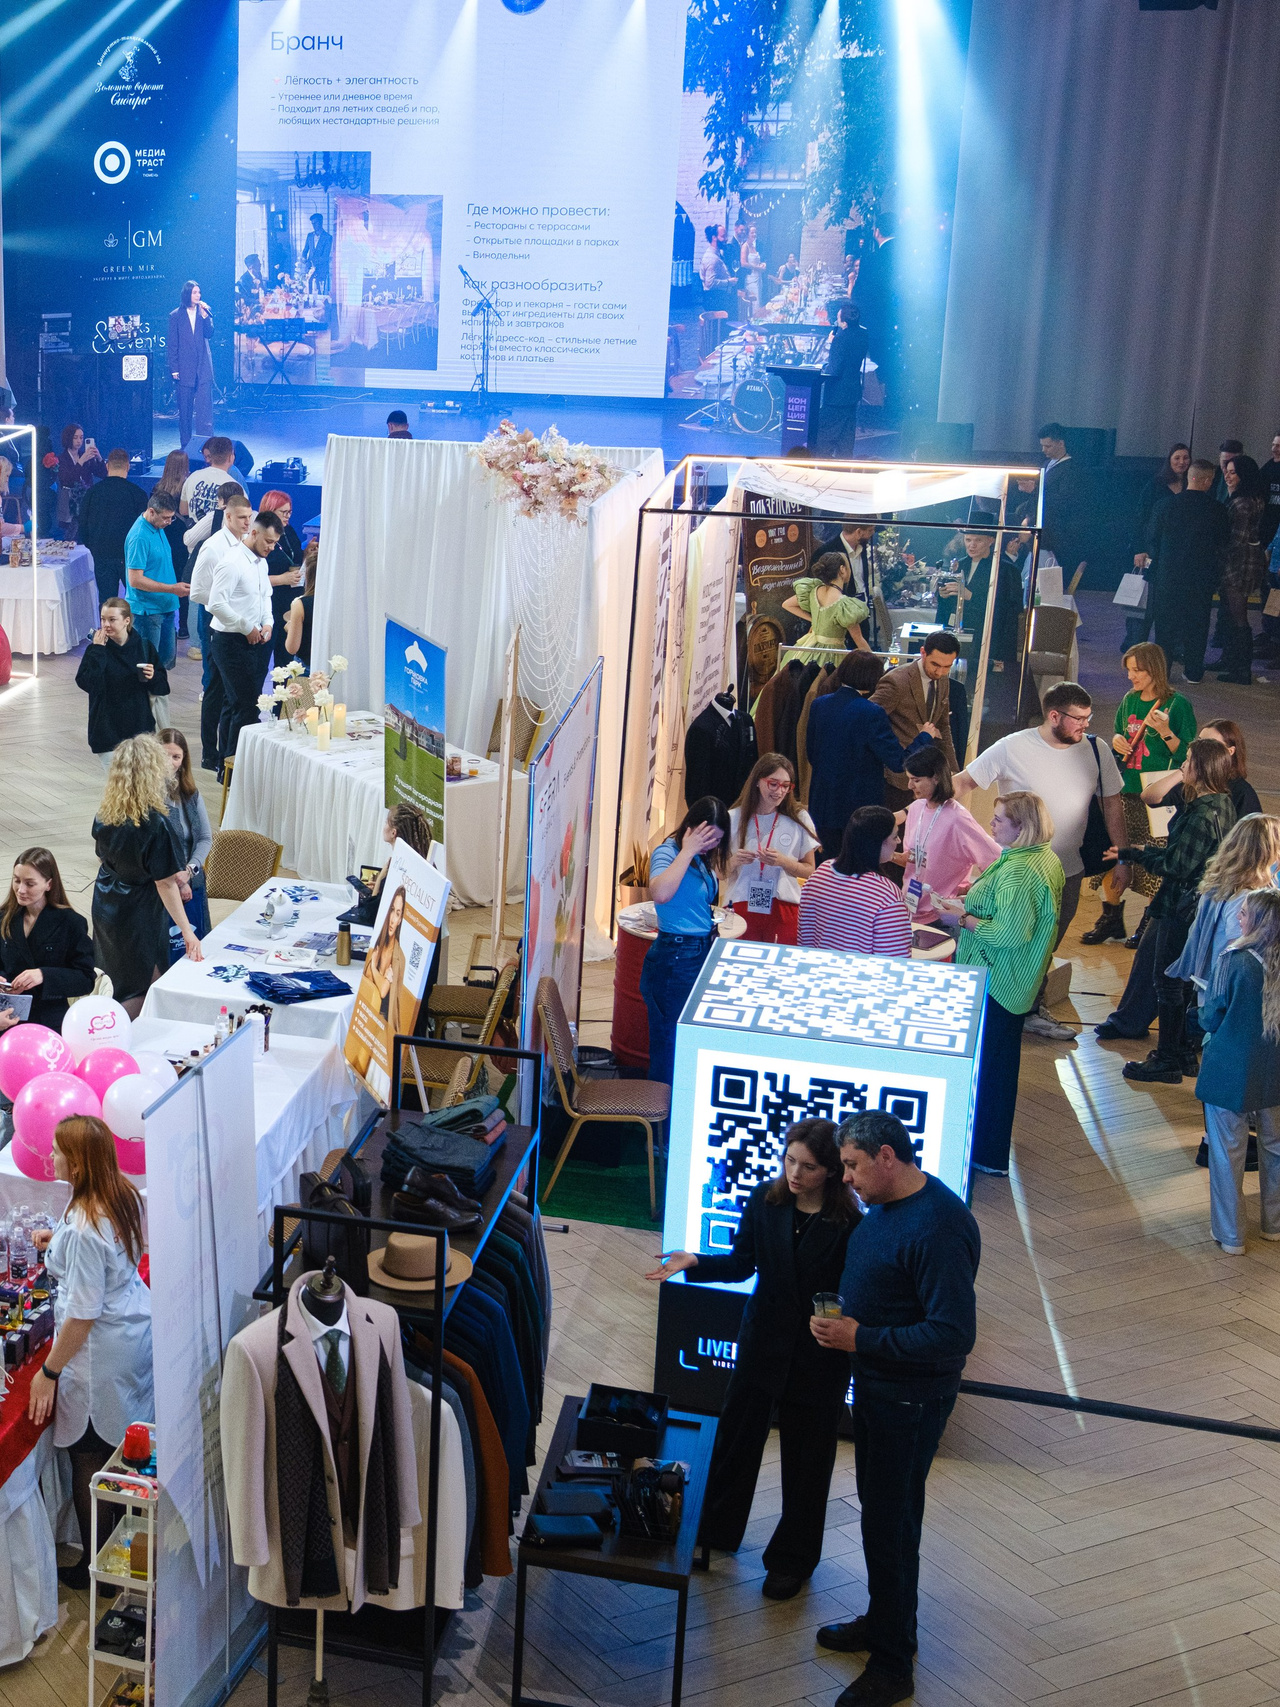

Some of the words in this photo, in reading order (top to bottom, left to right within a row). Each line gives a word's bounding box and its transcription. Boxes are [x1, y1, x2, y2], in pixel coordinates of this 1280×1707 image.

[271, 31, 343, 54] Бранч
[284, 75, 332, 85] Лёгкость
[345, 76, 419, 85] элегантность
[95, 81, 132, 93] Золотые
[134, 82, 164, 94] ворота
[278, 93, 321, 101] Утреннее
[278, 105, 321, 113] Подходит
[376, 104, 410, 113] свадеб
[278, 117, 320, 126] любящих
[322, 118, 395, 126] нестандартные
[397, 118, 440, 126] решения
[135, 149, 166, 157] МЕДИА
[136, 158, 164, 167] ТРАСТ
[467, 203, 489, 216] Где
[492, 206, 538, 216] можно
[542, 206, 610, 218] провести:
[474, 221, 527, 231] Рестораны
[537, 223, 591, 232] террасами
[132, 229, 162, 248] GM
[473, 236, 522, 245] Открытые
[524, 238, 574, 246] площадки
[584, 239, 620, 247] парках
[473, 251, 530, 260] Винодельни
[103, 265, 133, 273] GREEN
[138, 264, 155, 272] MIR
[463, 278, 487, 289] Как
[491, 279, 603, 292] разнообразить?
[462, 298, 513, 308] Фре-бар
[523, 301, 564, 309] пекарня
[462, 309, 510, 318] выают
[512, 311, 575, 320] ингредиенты
[577, 312, 594, 320] для
[462, 319, 505, 327] напиов
[515, 321, 564, 329] завтраков
[461, 332, 494, 342] Лёгкй
[496, 334, 545, 343] дресс-код
[555, 336, 601, 345] стильные
[603, 337, 637, 345] летние
[460, 343, 497, 351] нары
[535, 346, 601, 354] классических
[460, 353, 506, 361] костмов
[516, 355, 554, 363] платьев
[788, 397, 807, 405] КОН
[787, 404, 806, 412] ЦЕП
[402, 873, 436, 912] SPECIALIST
